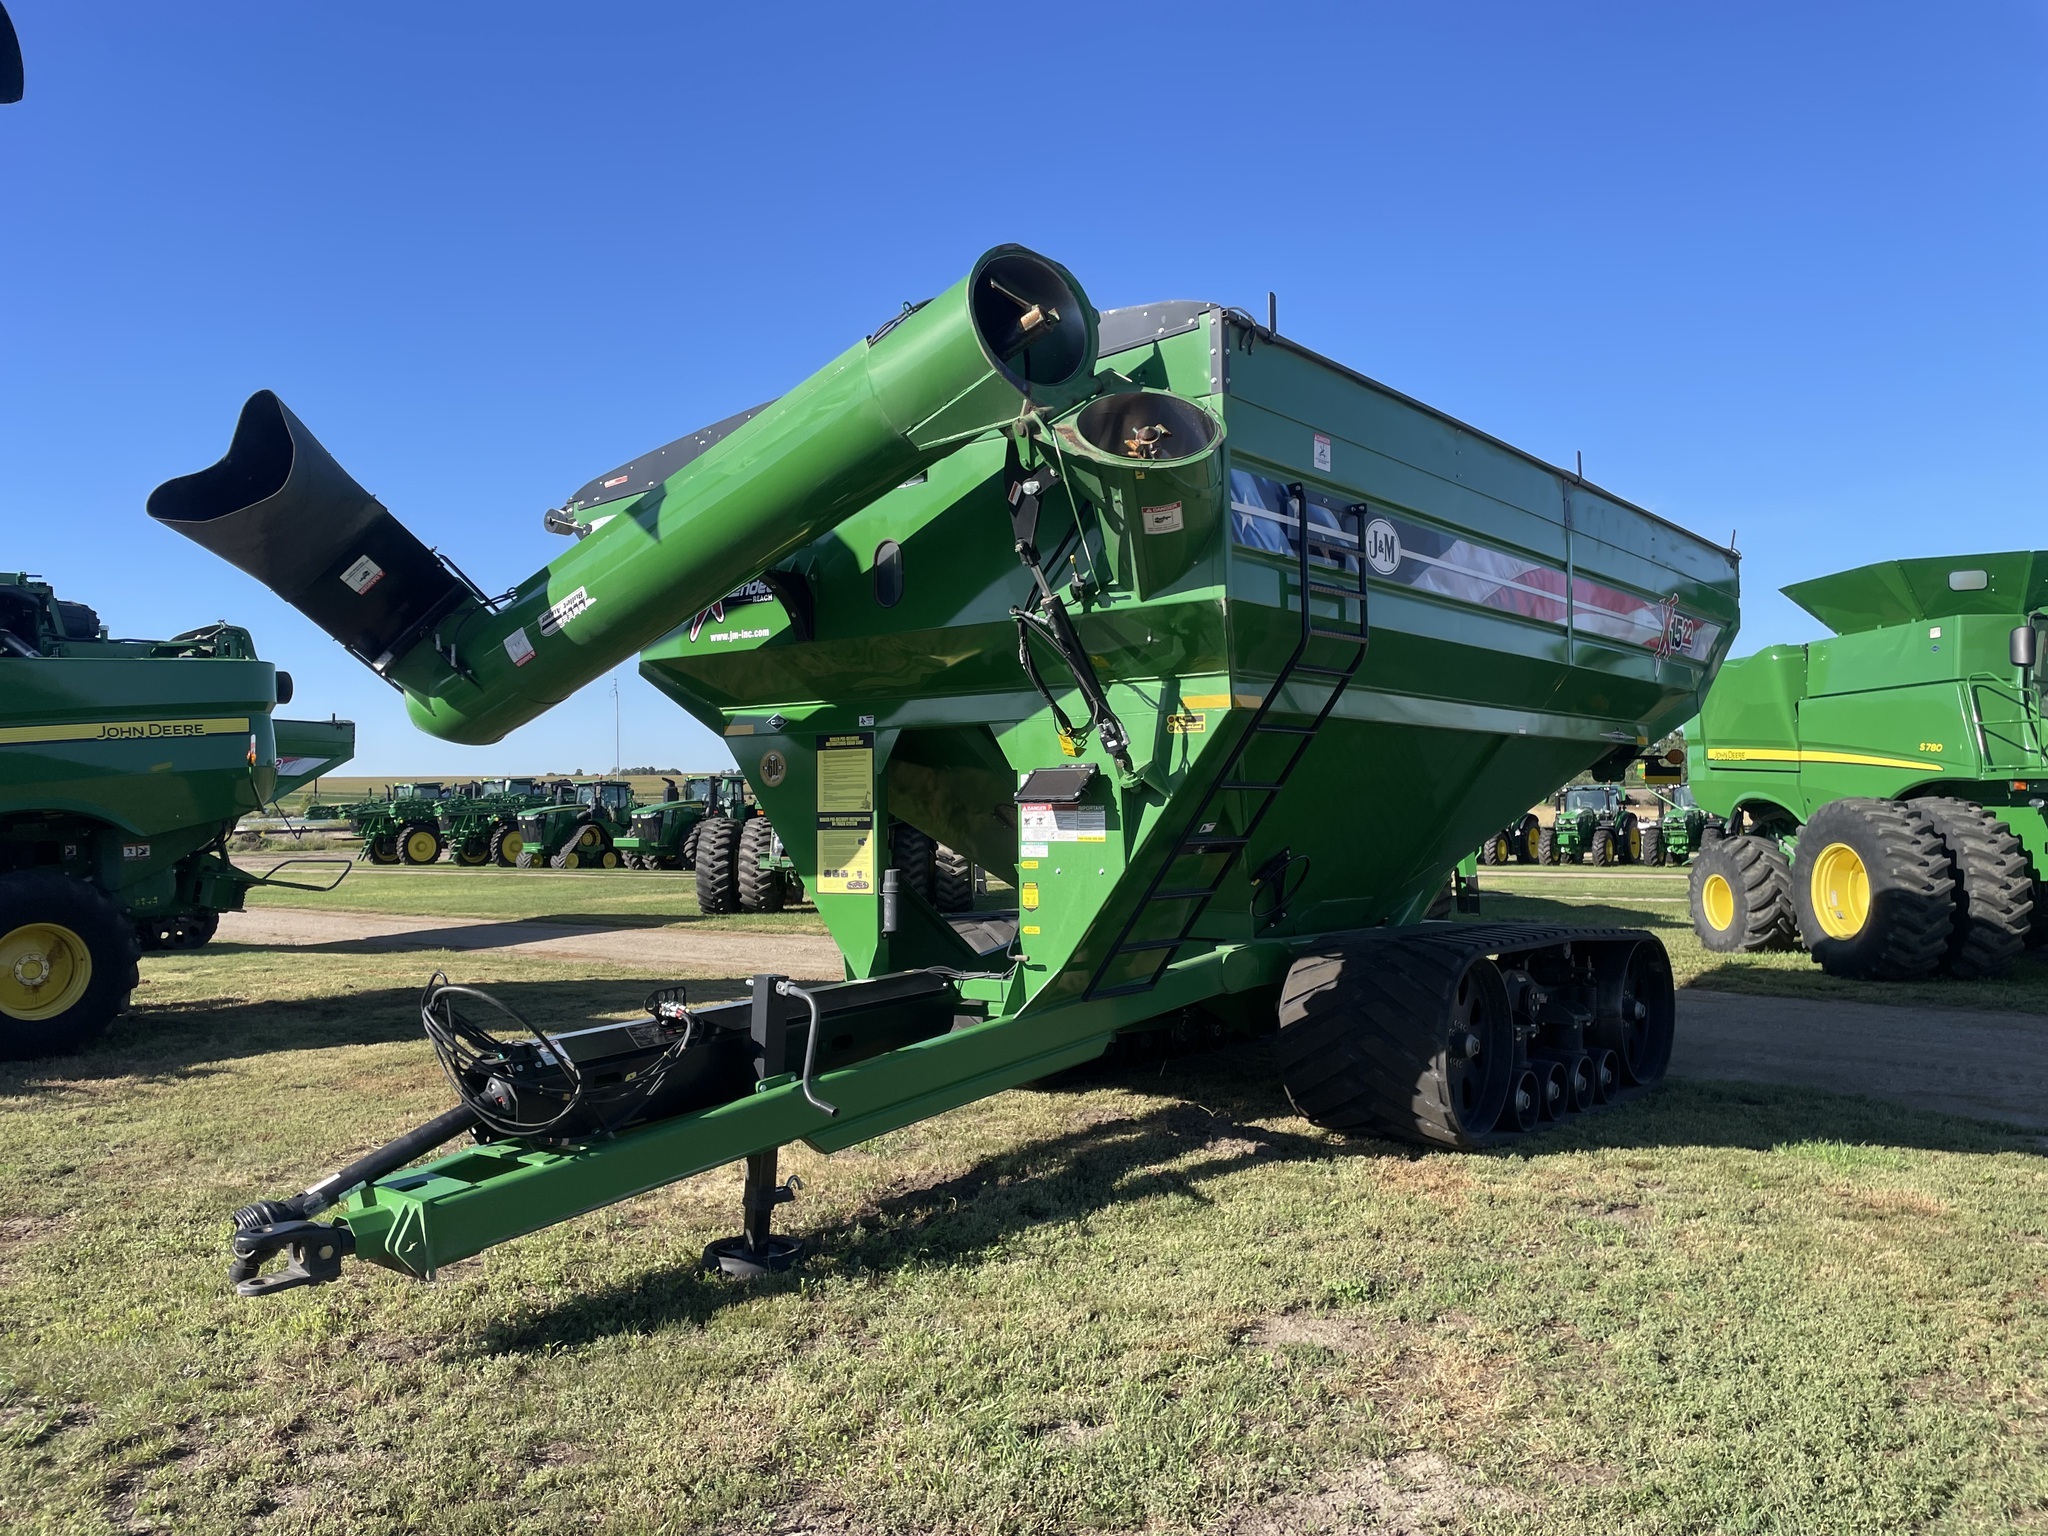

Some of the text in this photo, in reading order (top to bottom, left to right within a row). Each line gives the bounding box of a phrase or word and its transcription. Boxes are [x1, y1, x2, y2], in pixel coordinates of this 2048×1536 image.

[1368, 530, 1395, 564] J&M
[563, 591, 584, 608] Bullet
[752, 594, 773, 602] REACH
[710, 628, 770, 643] www.jm-inc.com
[97, 723, 205, 738] JOHN DEERE
[1714, 750, 1746, 759] JOHN DEERE
[1919, 742, 1943, 752] S780
